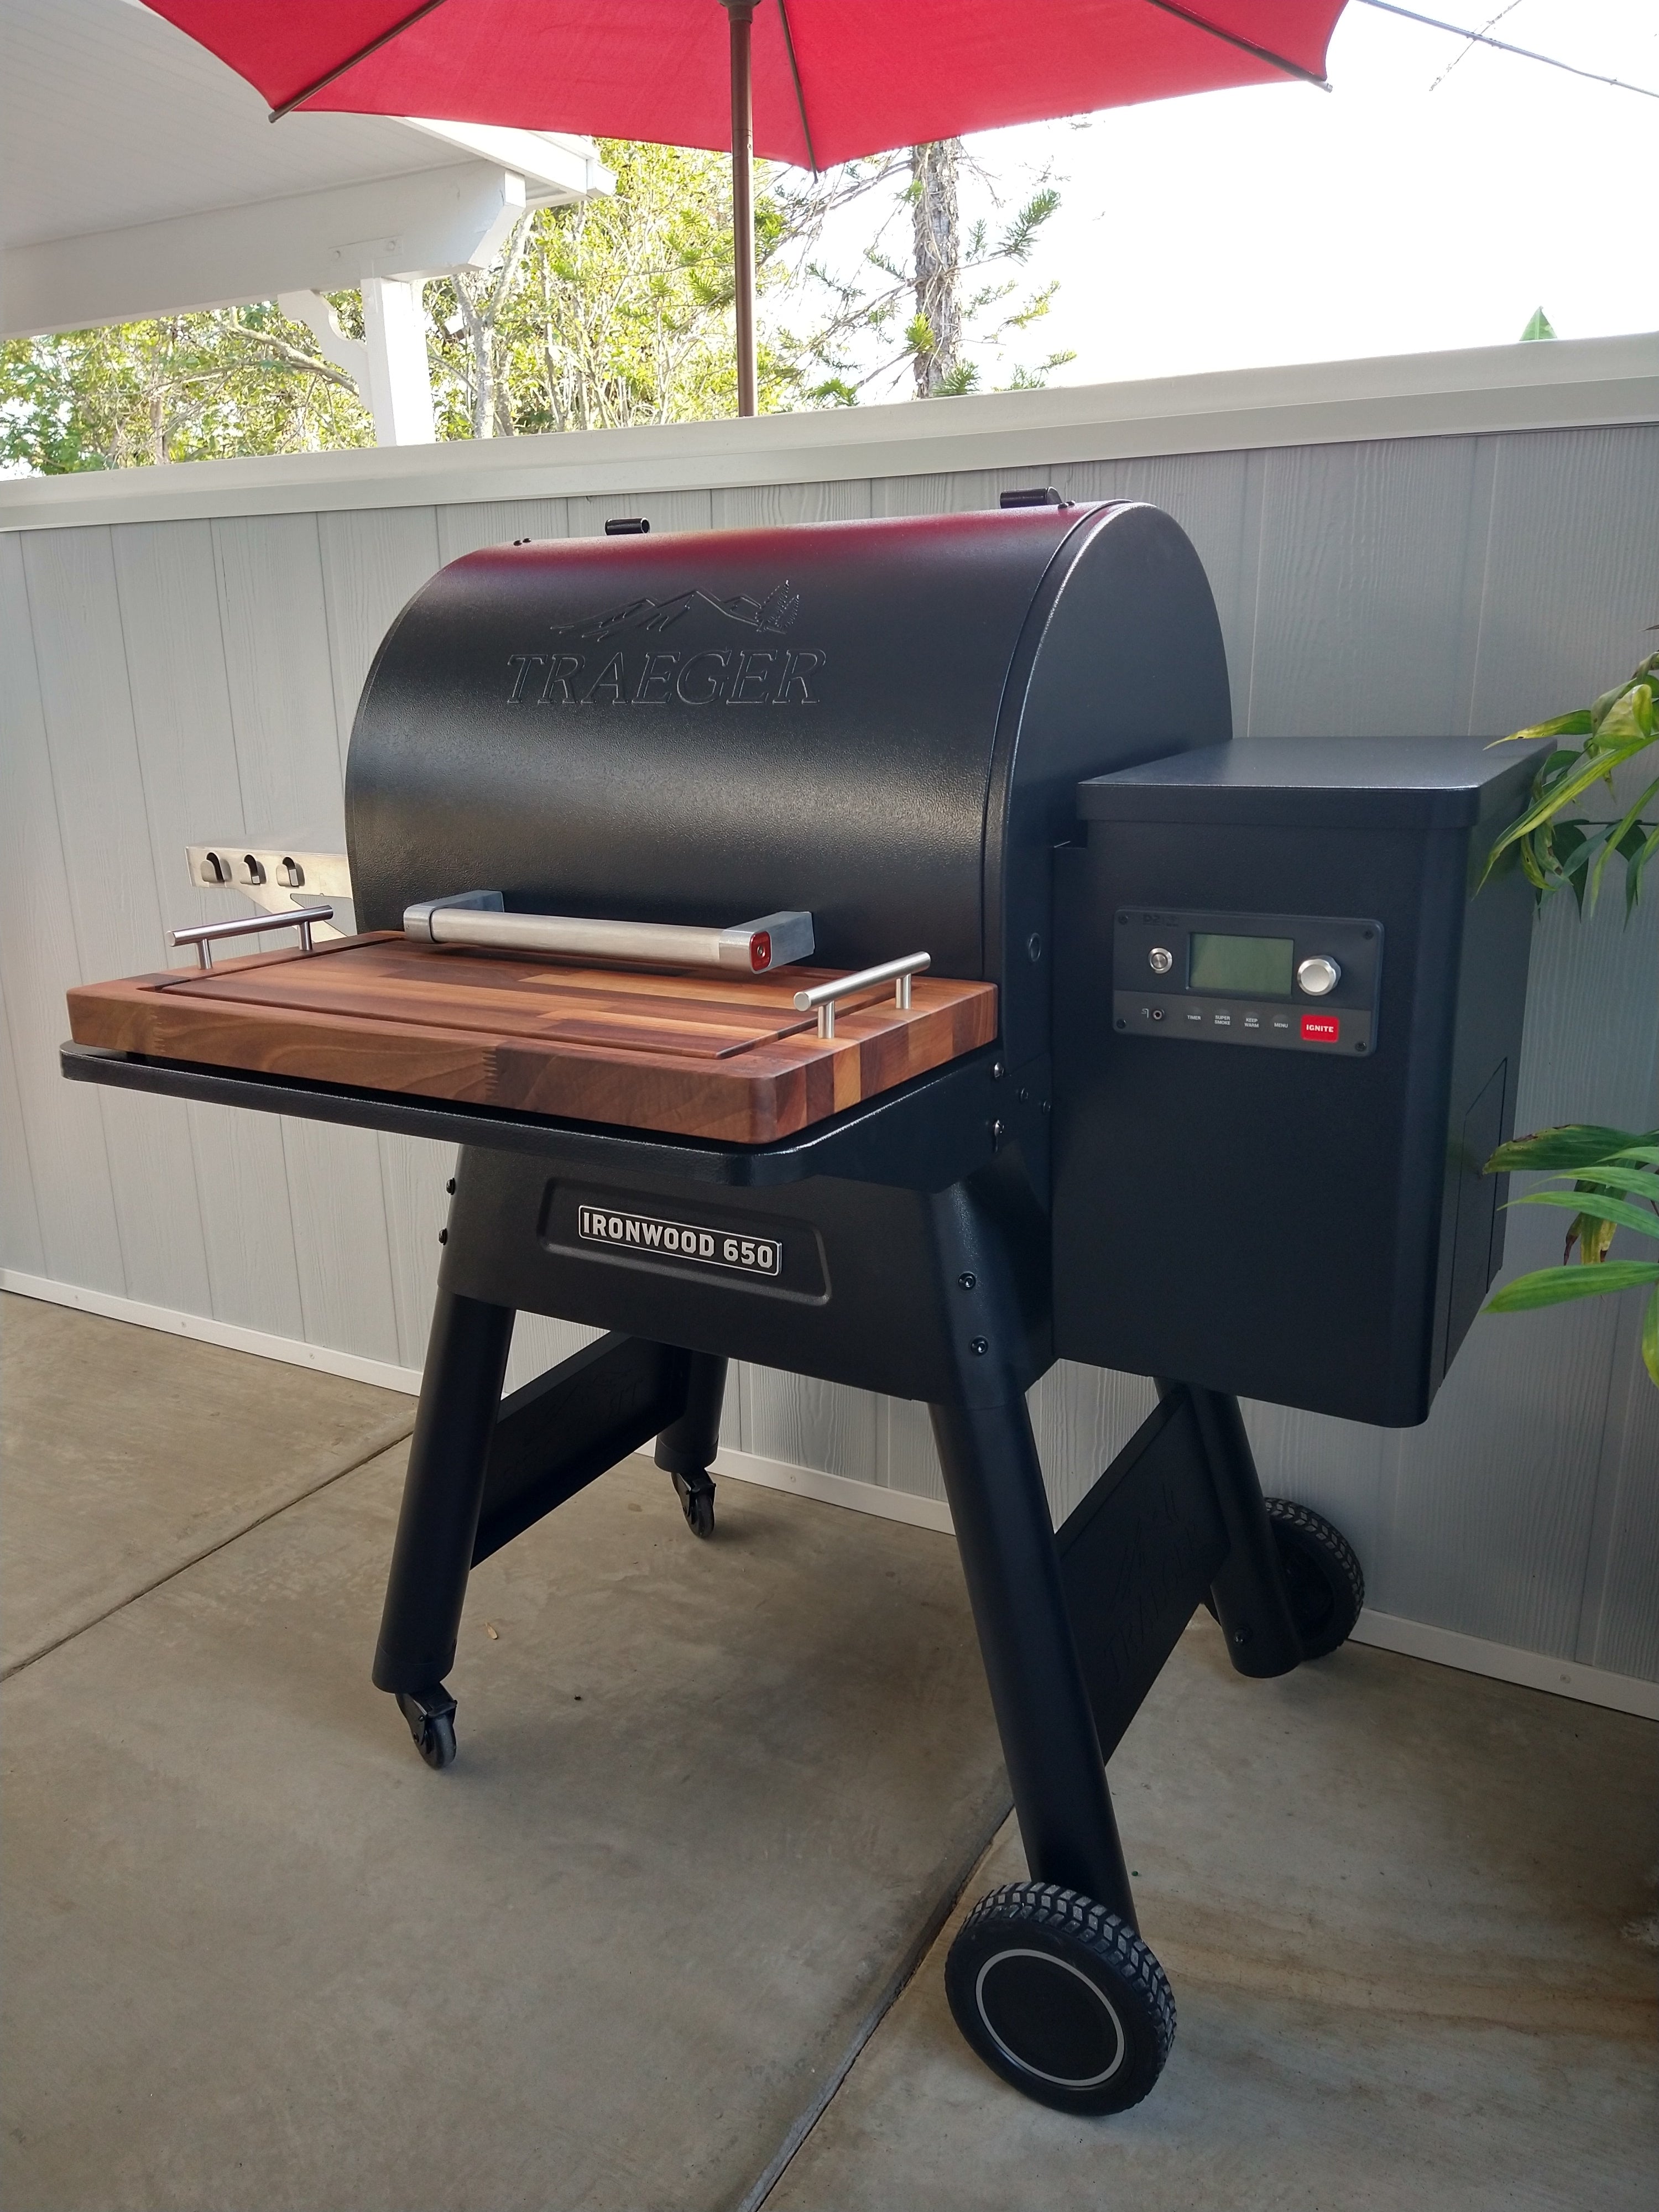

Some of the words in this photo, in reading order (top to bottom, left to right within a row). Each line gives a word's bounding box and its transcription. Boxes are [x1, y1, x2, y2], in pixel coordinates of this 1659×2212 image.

[507, 650, 825, 705] TRAEGER
[1306, 1024, 1334, 1032] IGNITE
[583, 1212, 714, 1257] IRONWOOD
[723, 1239, 773, 1269] 650
